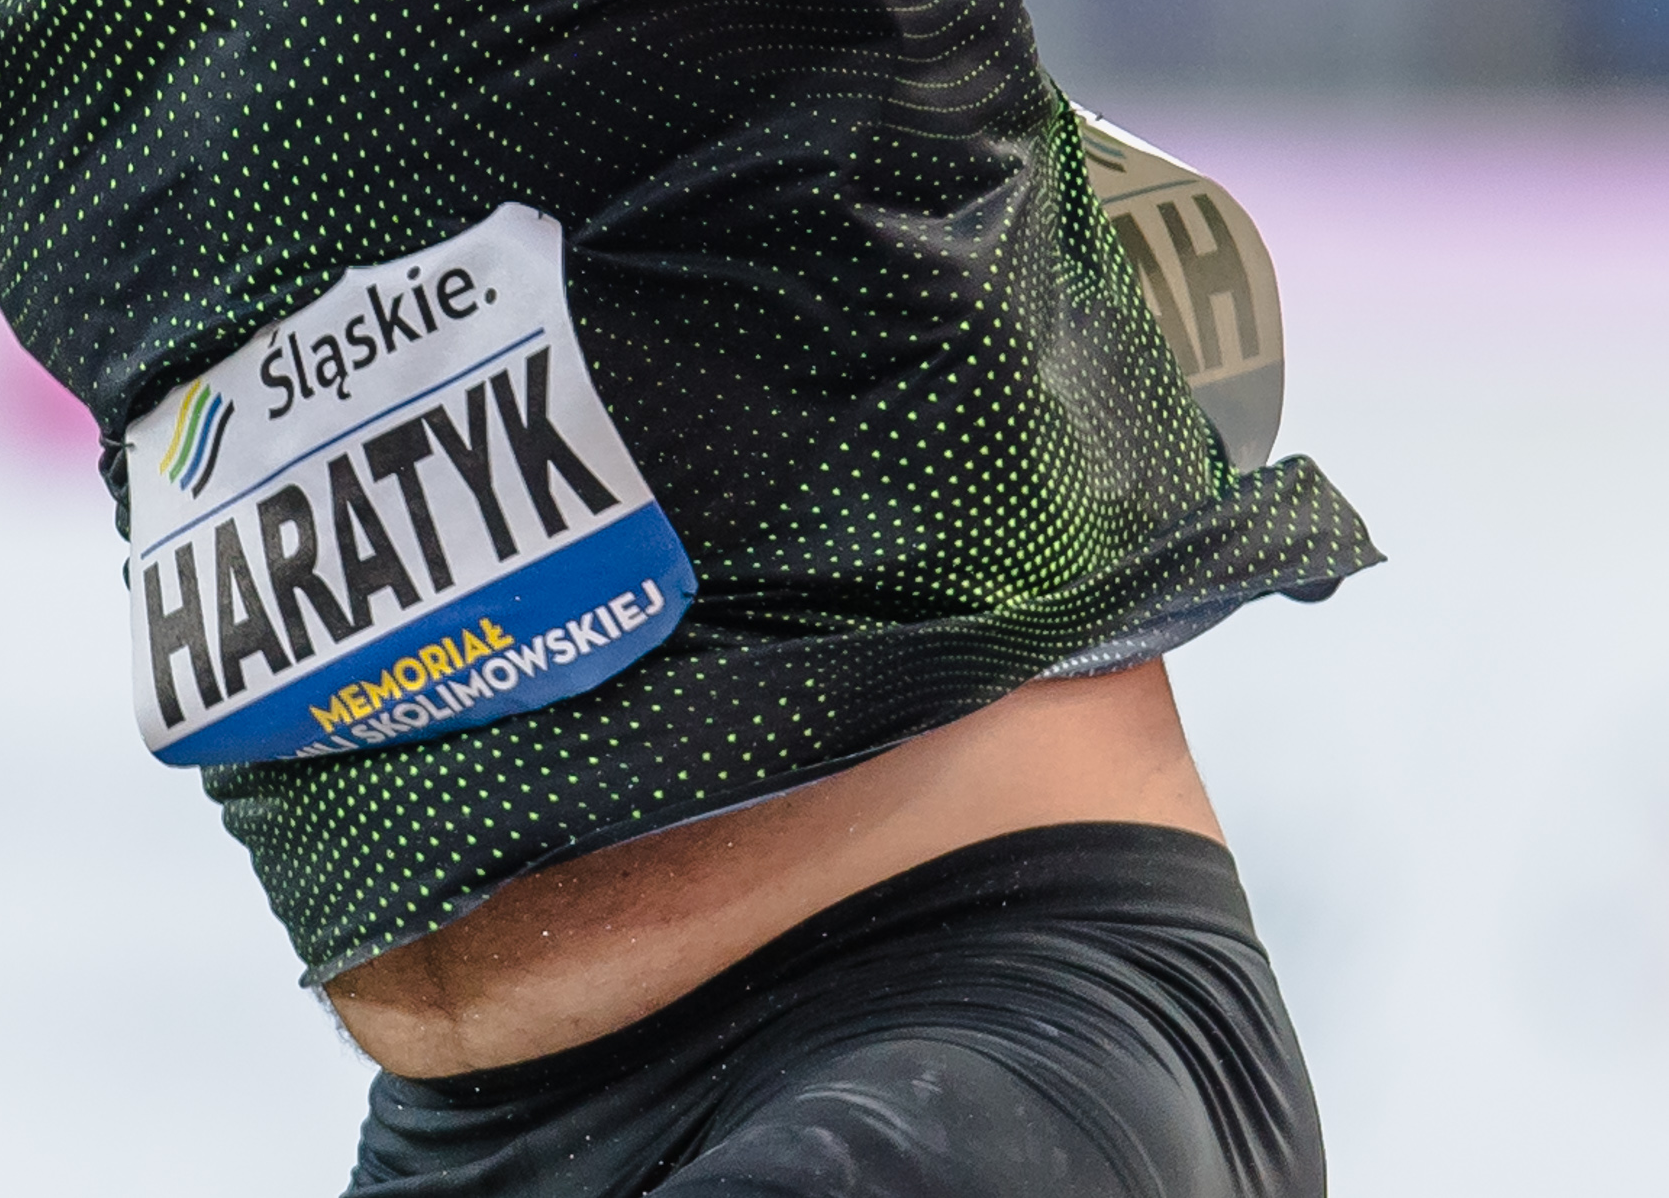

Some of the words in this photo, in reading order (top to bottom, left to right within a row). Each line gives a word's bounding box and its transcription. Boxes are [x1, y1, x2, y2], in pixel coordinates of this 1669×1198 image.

[141, 344, 623, 730] HARATYK
[308, 616, 515, 734] MEMORIAŁ
[350, 578, 666, 744] SKOLIMOWSKIEJ
